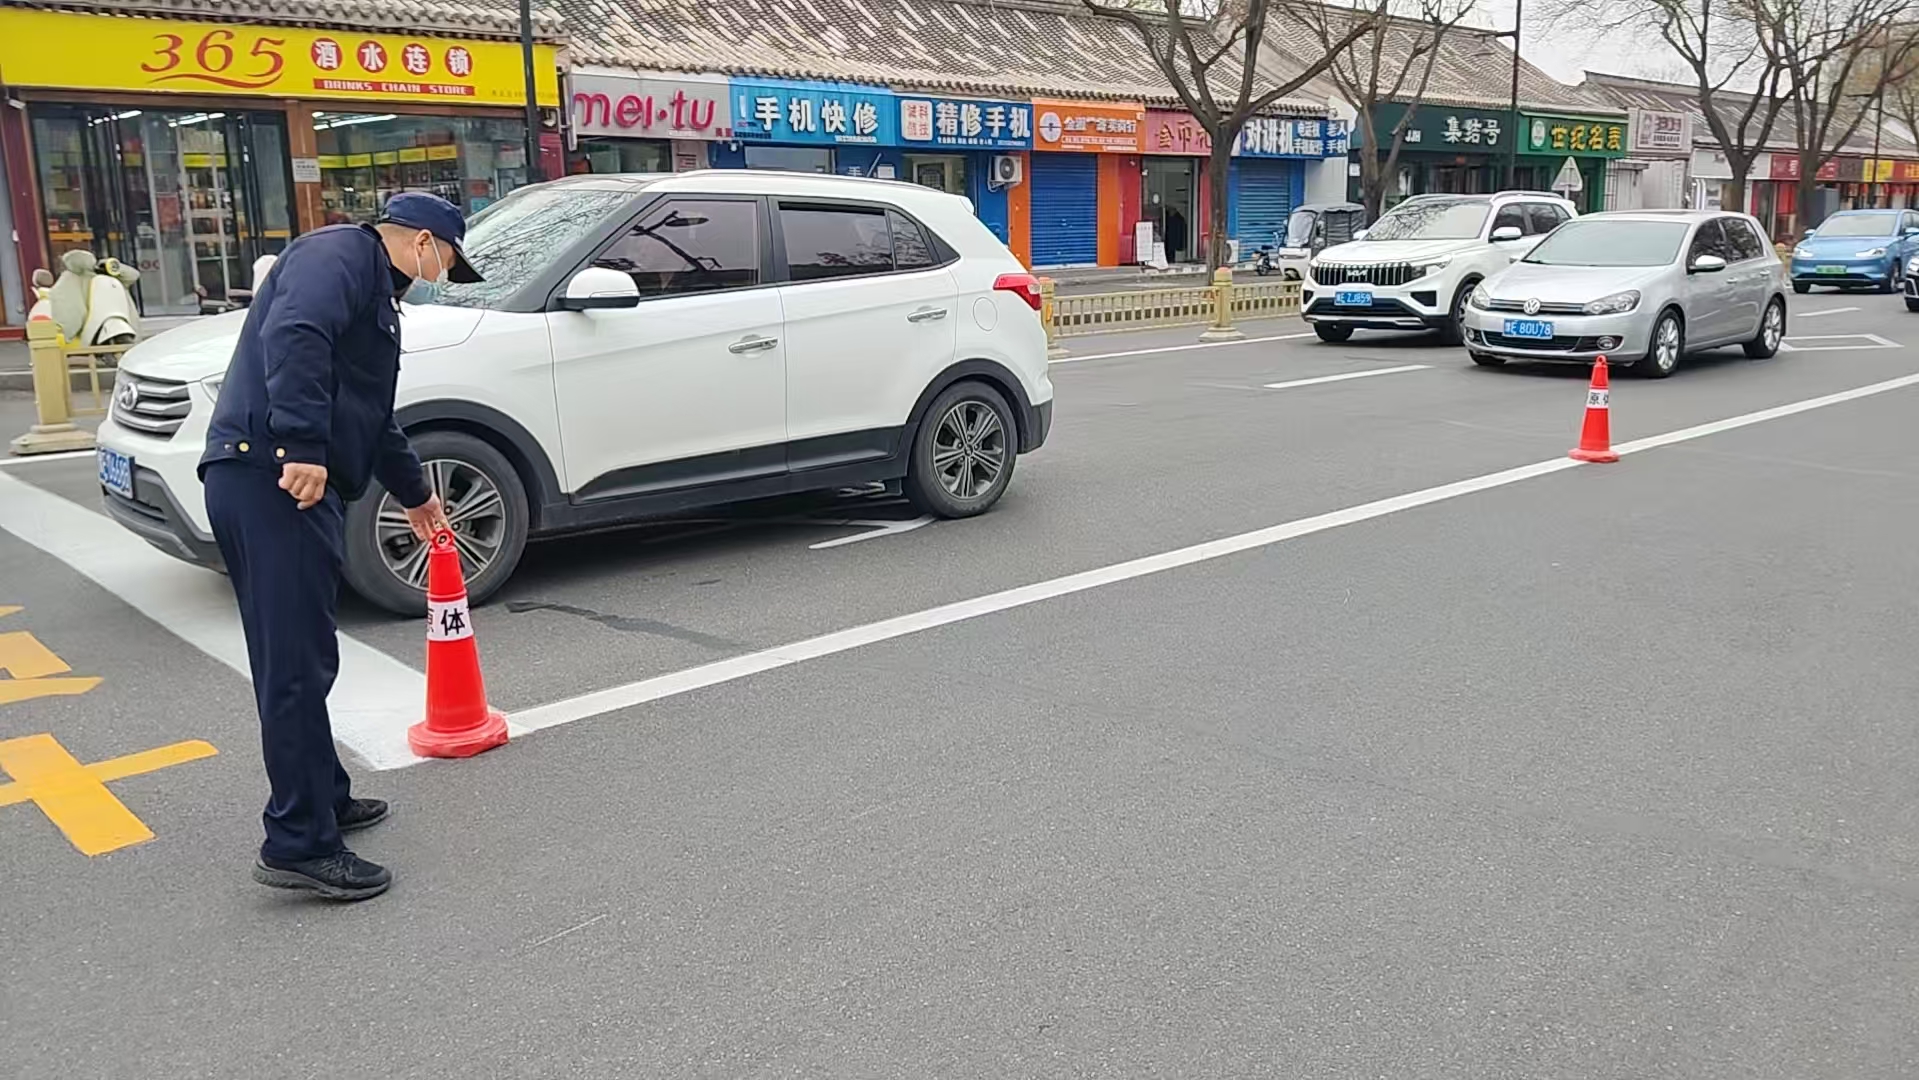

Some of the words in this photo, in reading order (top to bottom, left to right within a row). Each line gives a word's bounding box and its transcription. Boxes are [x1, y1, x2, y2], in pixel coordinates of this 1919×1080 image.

[141, 30, 285, 77] 365
[314, 40, 472, 76] 酒水连锁
[323, 79, 373, 92] DRINKS
[381, 82, 421, 93] CHAIN
[429, 84, 468, 95] STORE
[754, 96, 879, 135] 手机快修
[935, 102, 1031, 138] 精修手机
[1441, 115, 1501, 146] 集结号
[1246, 119, 1293, 155] 对讲机
[1326, 139, 1347, 154] 手机
[1551, 123, 1622, 151] 世纪名表
